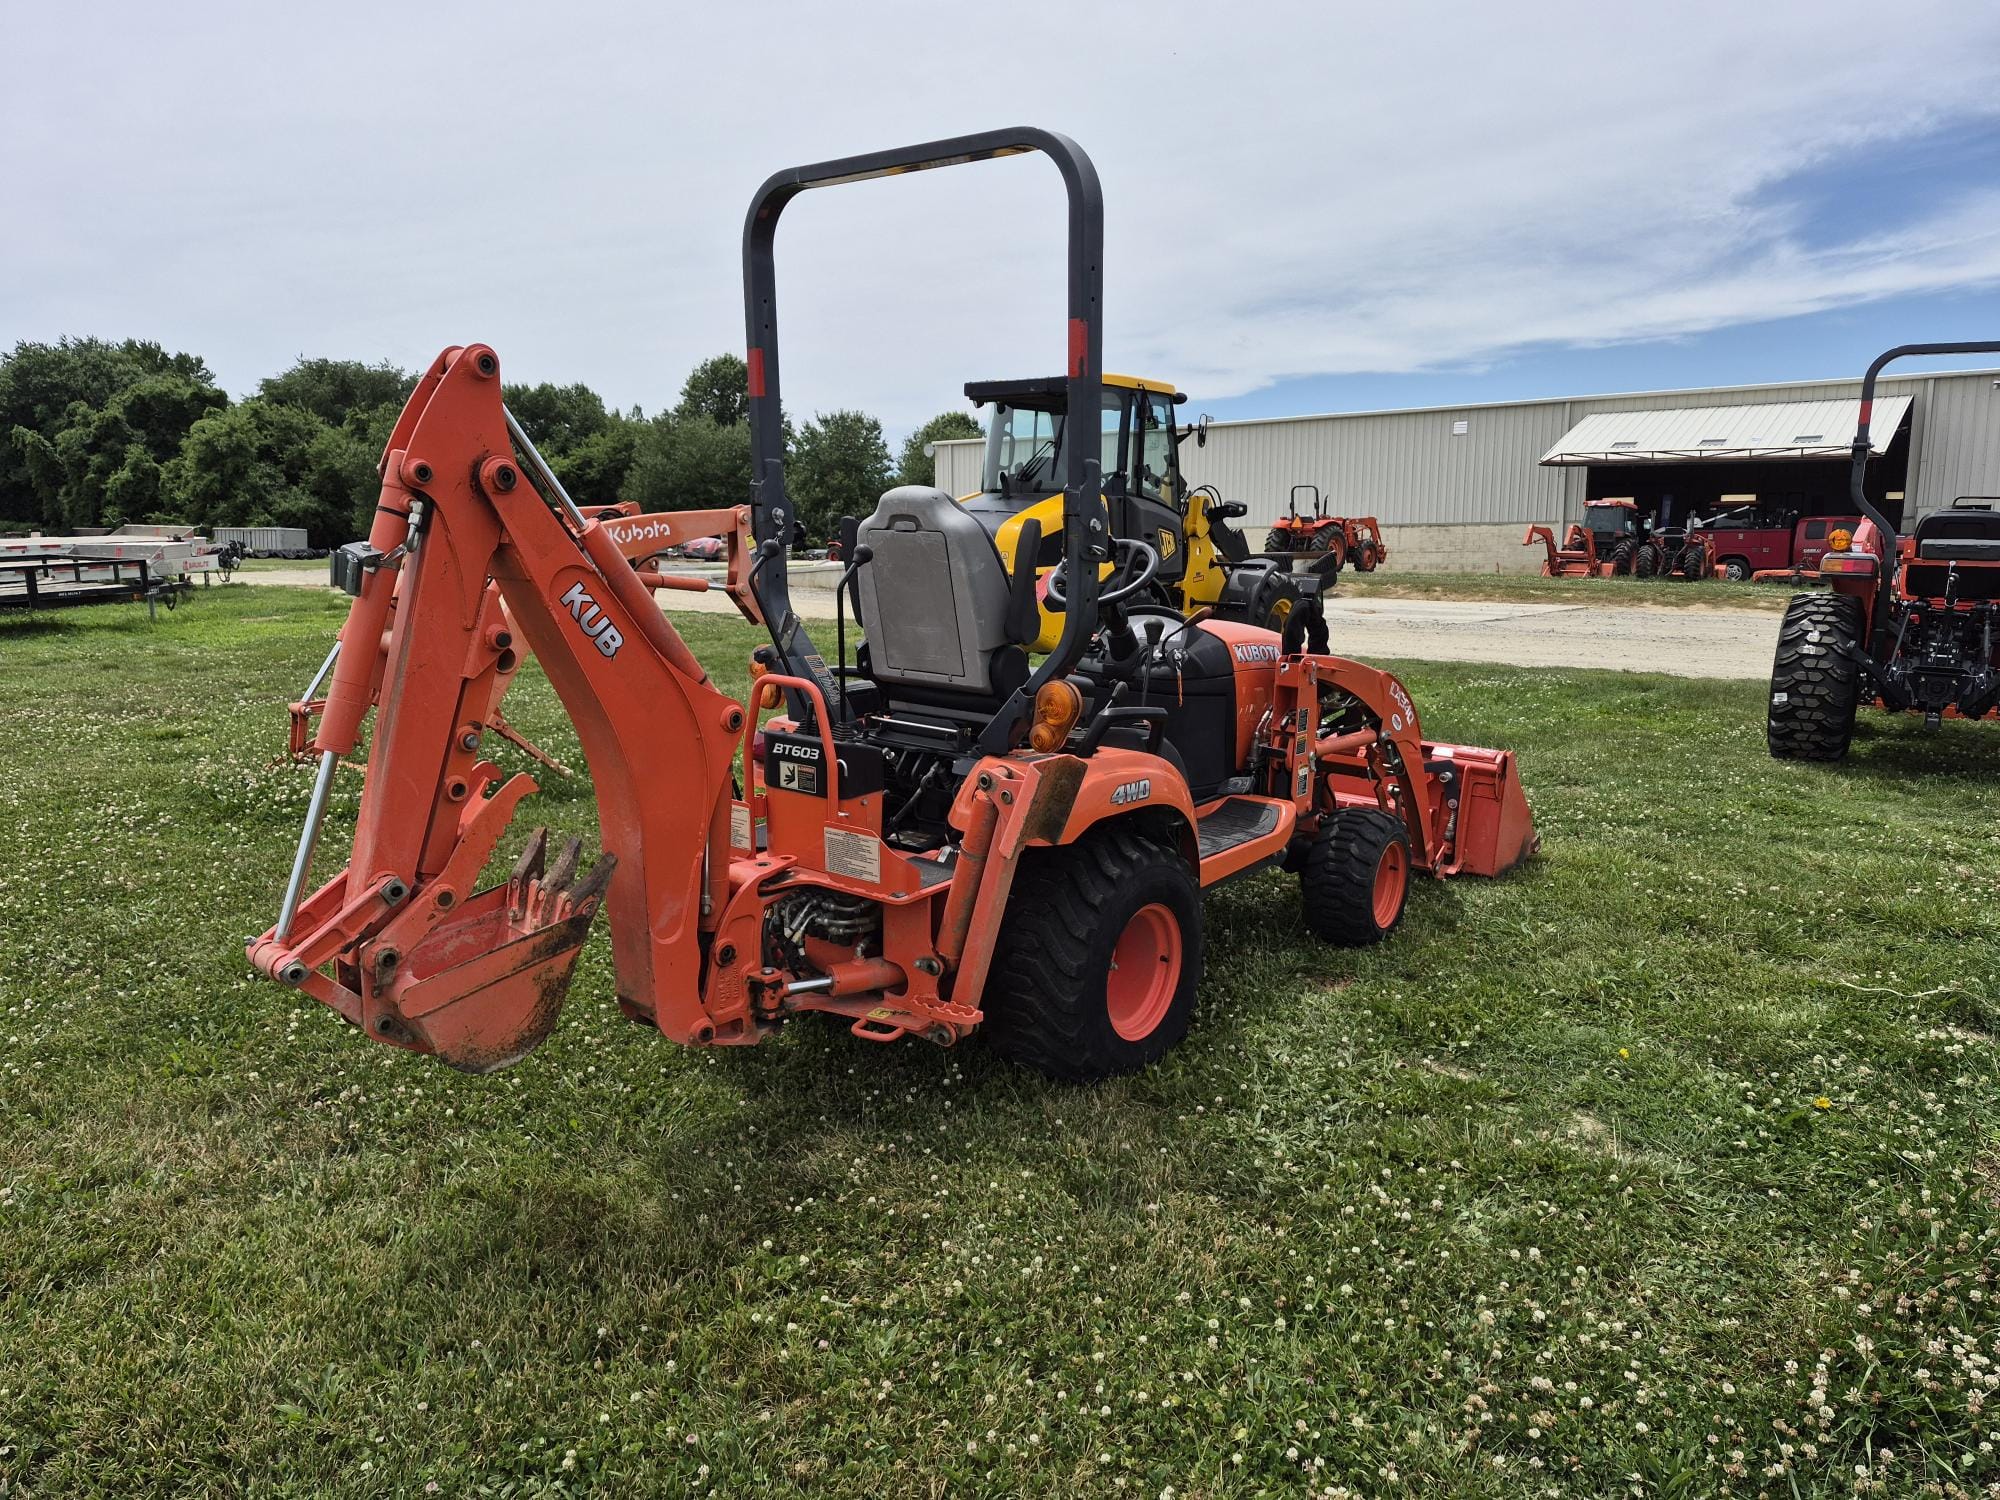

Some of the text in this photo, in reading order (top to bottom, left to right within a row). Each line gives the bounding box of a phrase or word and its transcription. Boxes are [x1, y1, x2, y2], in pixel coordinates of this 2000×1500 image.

[608, 520, 671, 543] Kubota
[1160, 530, 1176, 559] JCB
[560, 581, 624, 657] KUB
[1233, 645, 1281, 662] KUBOTA
[772, 742, 820, 760] BT603
[1110, 779, 1151, 804] 4WD
